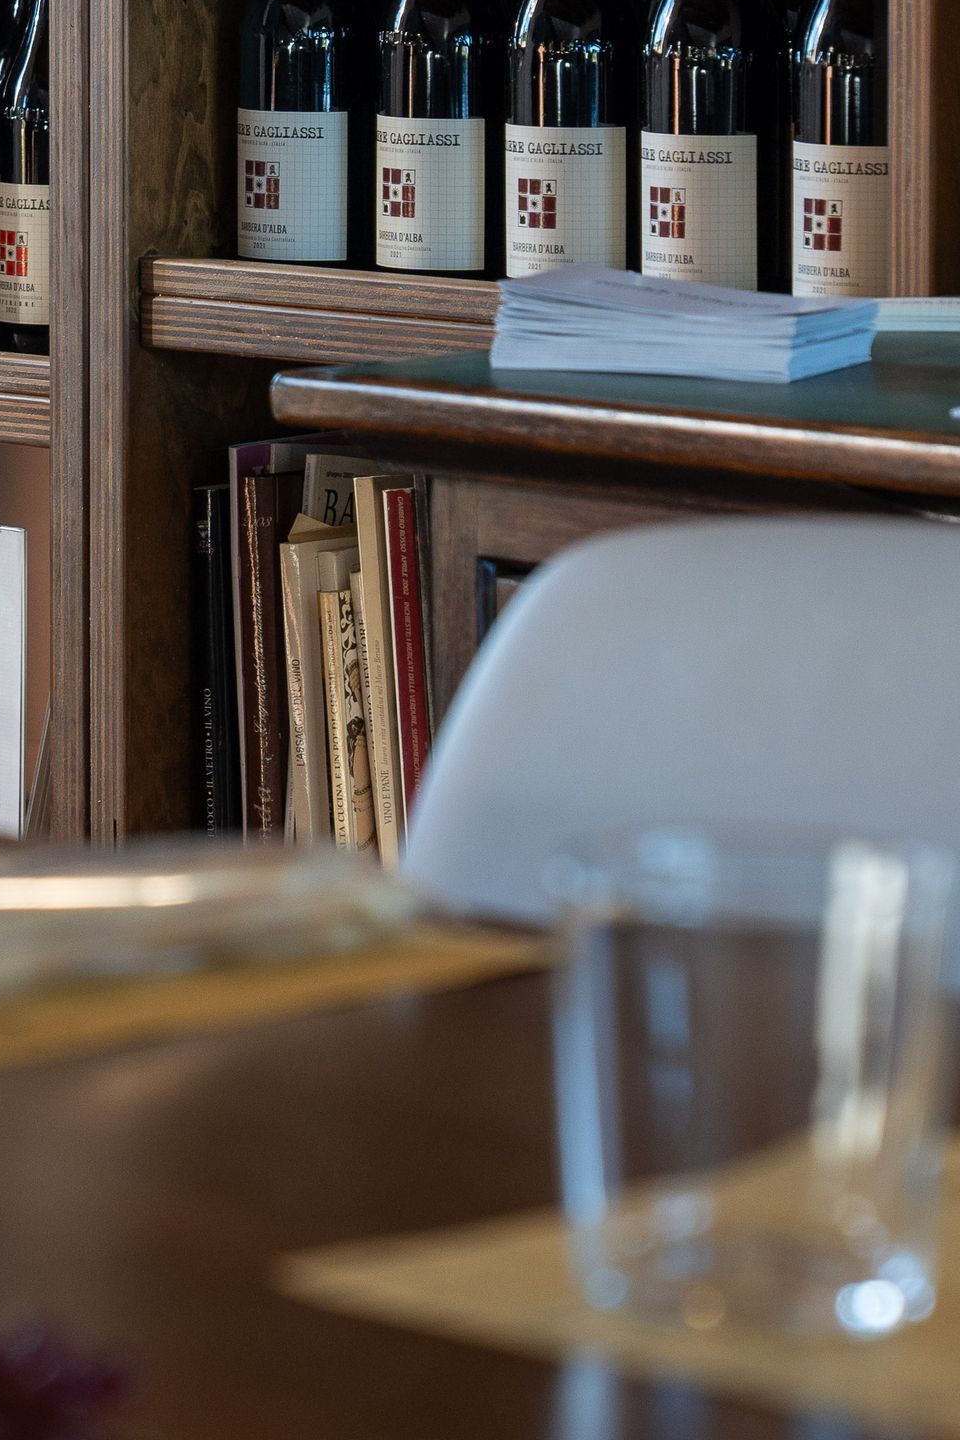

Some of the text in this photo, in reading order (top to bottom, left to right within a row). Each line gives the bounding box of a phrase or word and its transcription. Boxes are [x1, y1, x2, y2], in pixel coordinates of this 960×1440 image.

[253, 126, 324, 139] GAGLIASSI
[390, 132, 461, 146] GAGLIASSI
[527, 142, 603, 156] GAGLIASSI
[658, 150, 733, 165] GAGLIASSI
[813, 161, 889, 176] GAGLIASSI
[262, 223, 287, 234] D'ALBA
[379, 230, 423, 243] BARBERA D'ALBA
[512, 242, 565, 255] BARBERA D'ALBA
[645, 251, 694, 265] BARBERA D'ALBA
[798, 263, 850, 278] BARBERA D'ALBA
[13, 281, 36, 293] D'ALBA
[397, 495, 405, 529] GAMBERO
[399, 529, 407, 553] ROSSO
[401, 555, 409, 577] APRILE
[402, 578, 410, 596] 2002
[406, 642, 415, 672] MERCATI
[291, 658, 301, 684] VINO
[408, 673, 416, 693] DELLE
[203, 688, 213, 718] VINO
[203, 719, 213, 730] IL
[204, 739, 214, 776] VETRO
[411, 728, 420, 778] SUPERMERCATI
[334, 754, 341, 770] UN
[205, 779, 214, 789] IL
[380, 769, 390, 792] PANE
[336, 783, 345, 823] CUCINA
[382, 801, 393, 825] VINO
